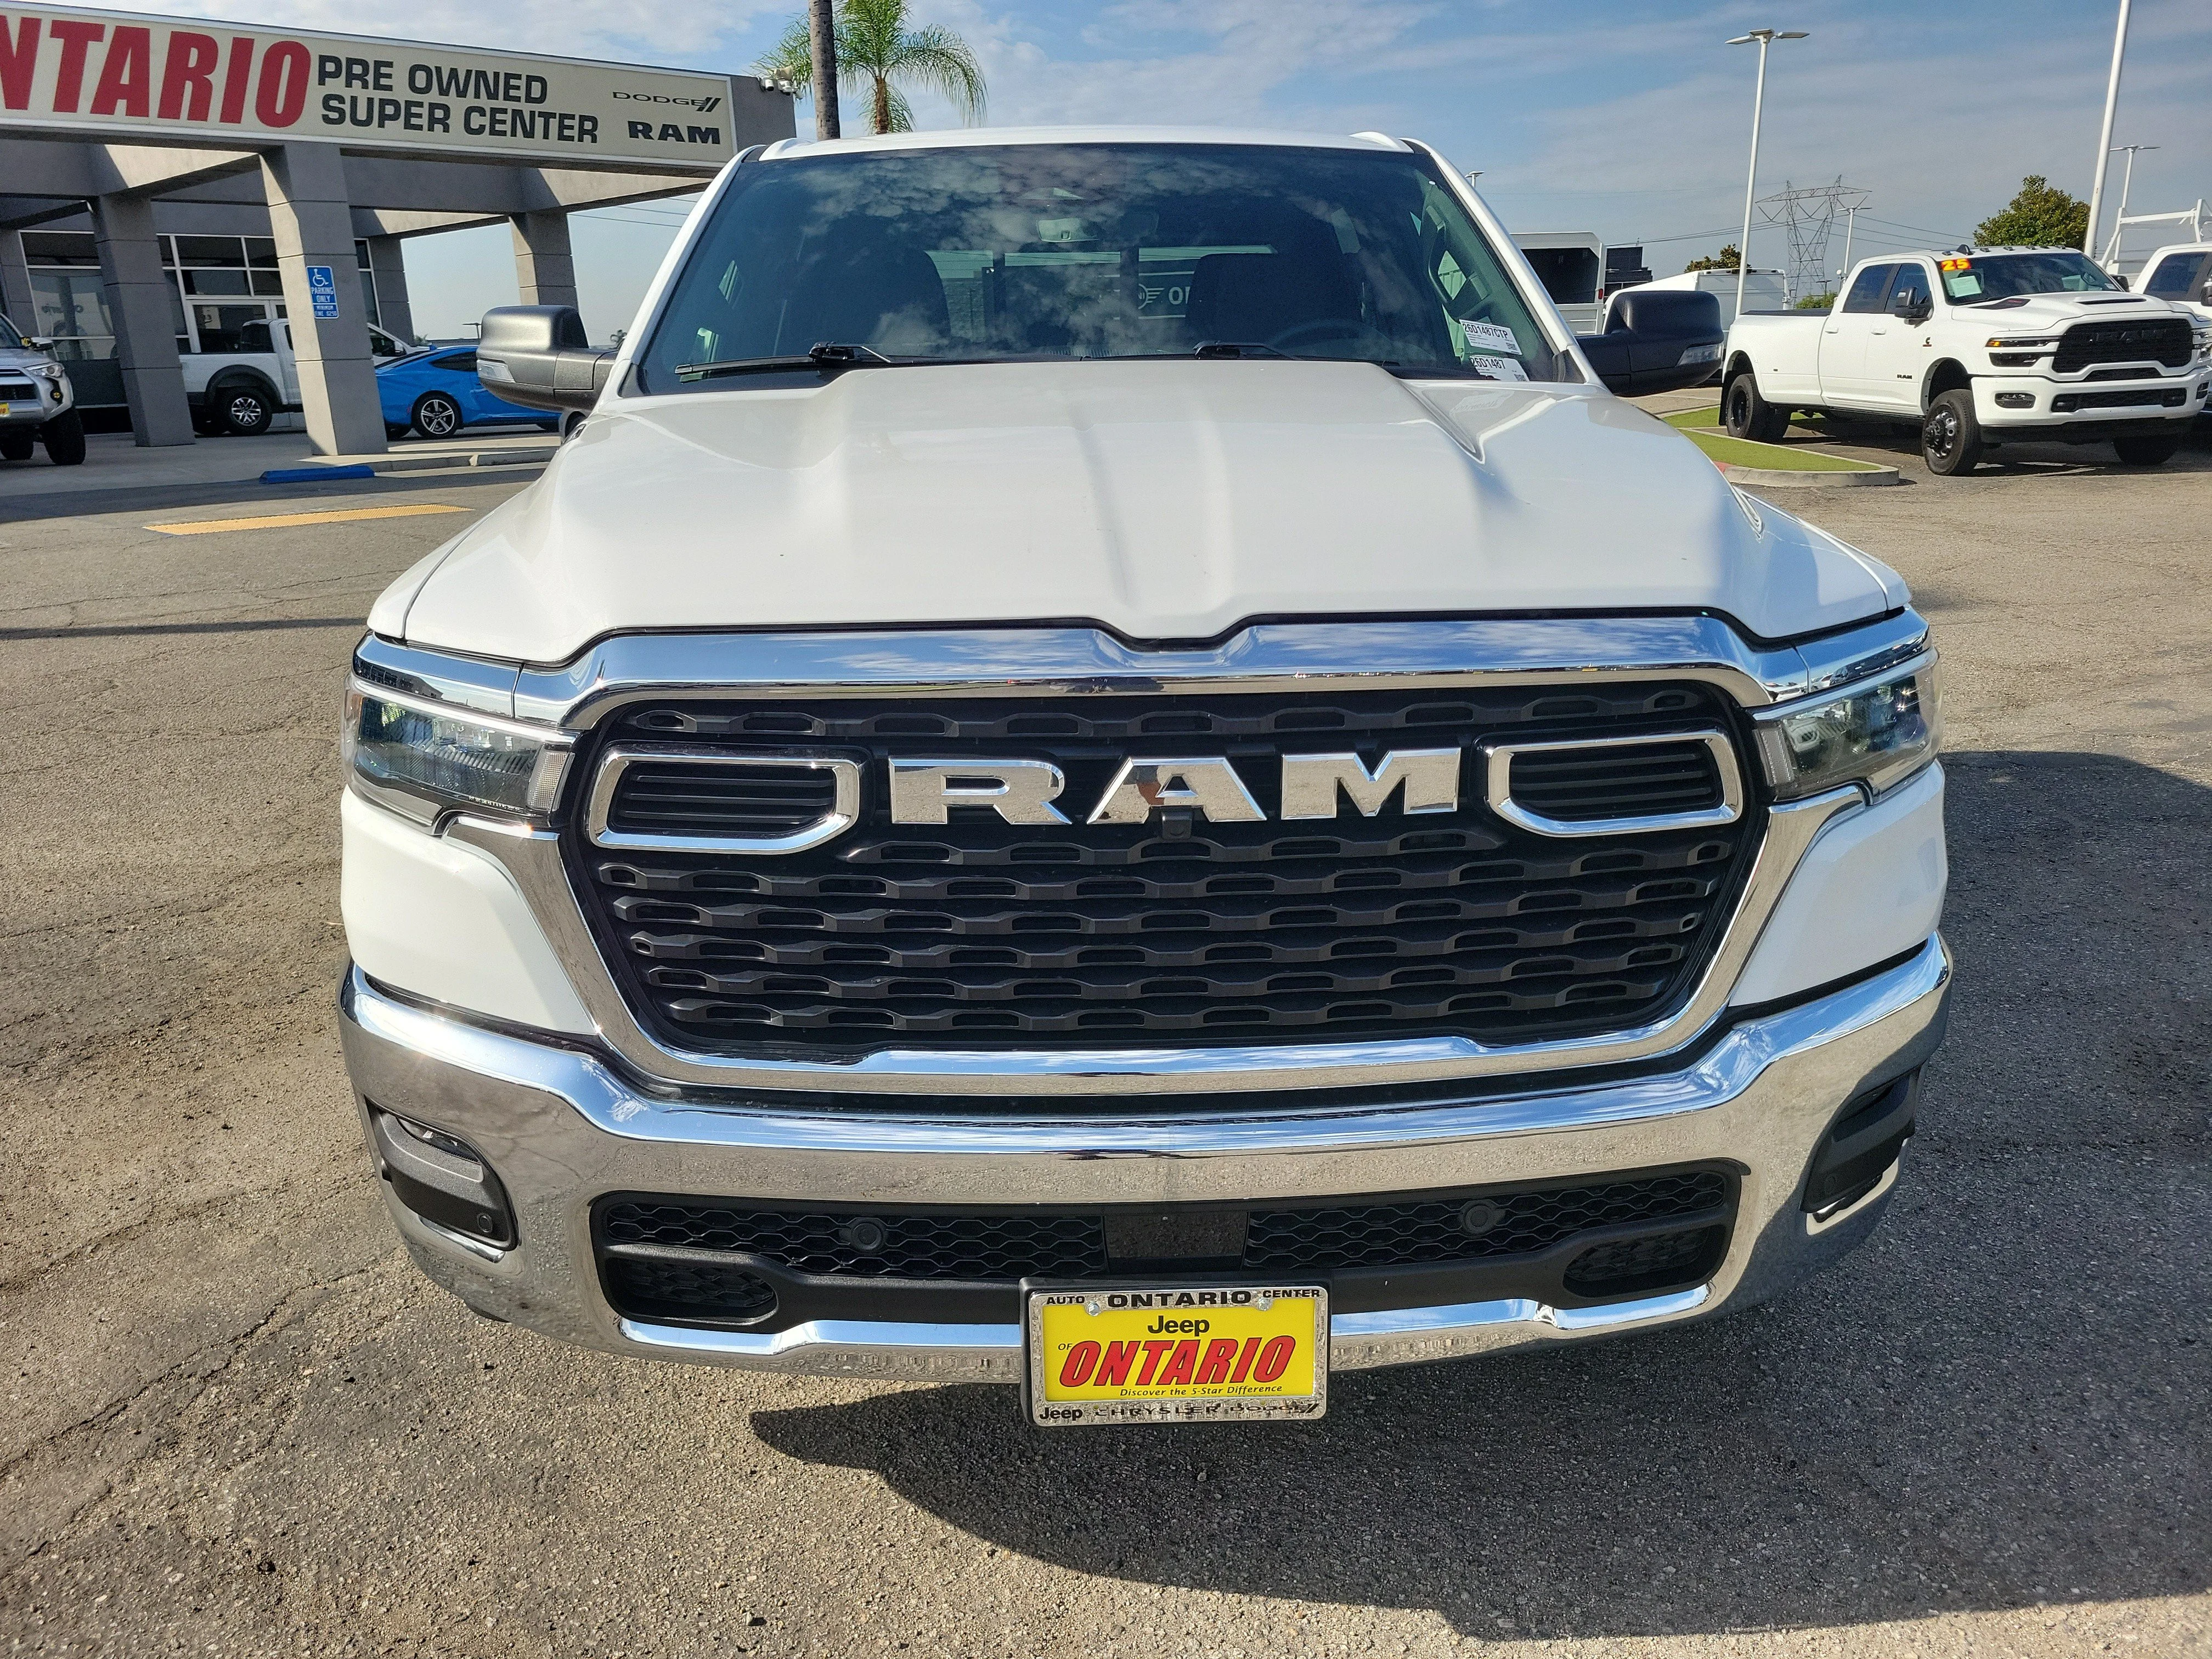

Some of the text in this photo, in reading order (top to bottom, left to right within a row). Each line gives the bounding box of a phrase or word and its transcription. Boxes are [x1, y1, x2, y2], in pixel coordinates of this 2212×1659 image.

[318, 54, 548, 104] PRE OWNED
[613, 92, 708, 106] DODGE
[321, 94, 598, 144] SUPER CENTER
[628, 121, 720, 144] RAM
[1942, 258, 1969, 271] 25
[1463, 323, 1508, 338] 26D1487CTP
[1470, 357, 1506, 369] 26D1487
[889, 748, 1462, 825] RAM
[1046, 1289, 1320, 1307] AUTO ONTARIO CENTER
[1148, 1315, 1210, 1336] Jeep
[1059, 1335, 1296, 1387] ONTARIO
[1120, 1388, 1166, 1396] Discover
[1191, 1387, 1223, 1395] 5-Star
[1227, 1385, 1283, 1395] Difference
[1040, 1407, 1083, 1421] Jeep
[1096, 1404, 1219, 1416] CHRYSLER
